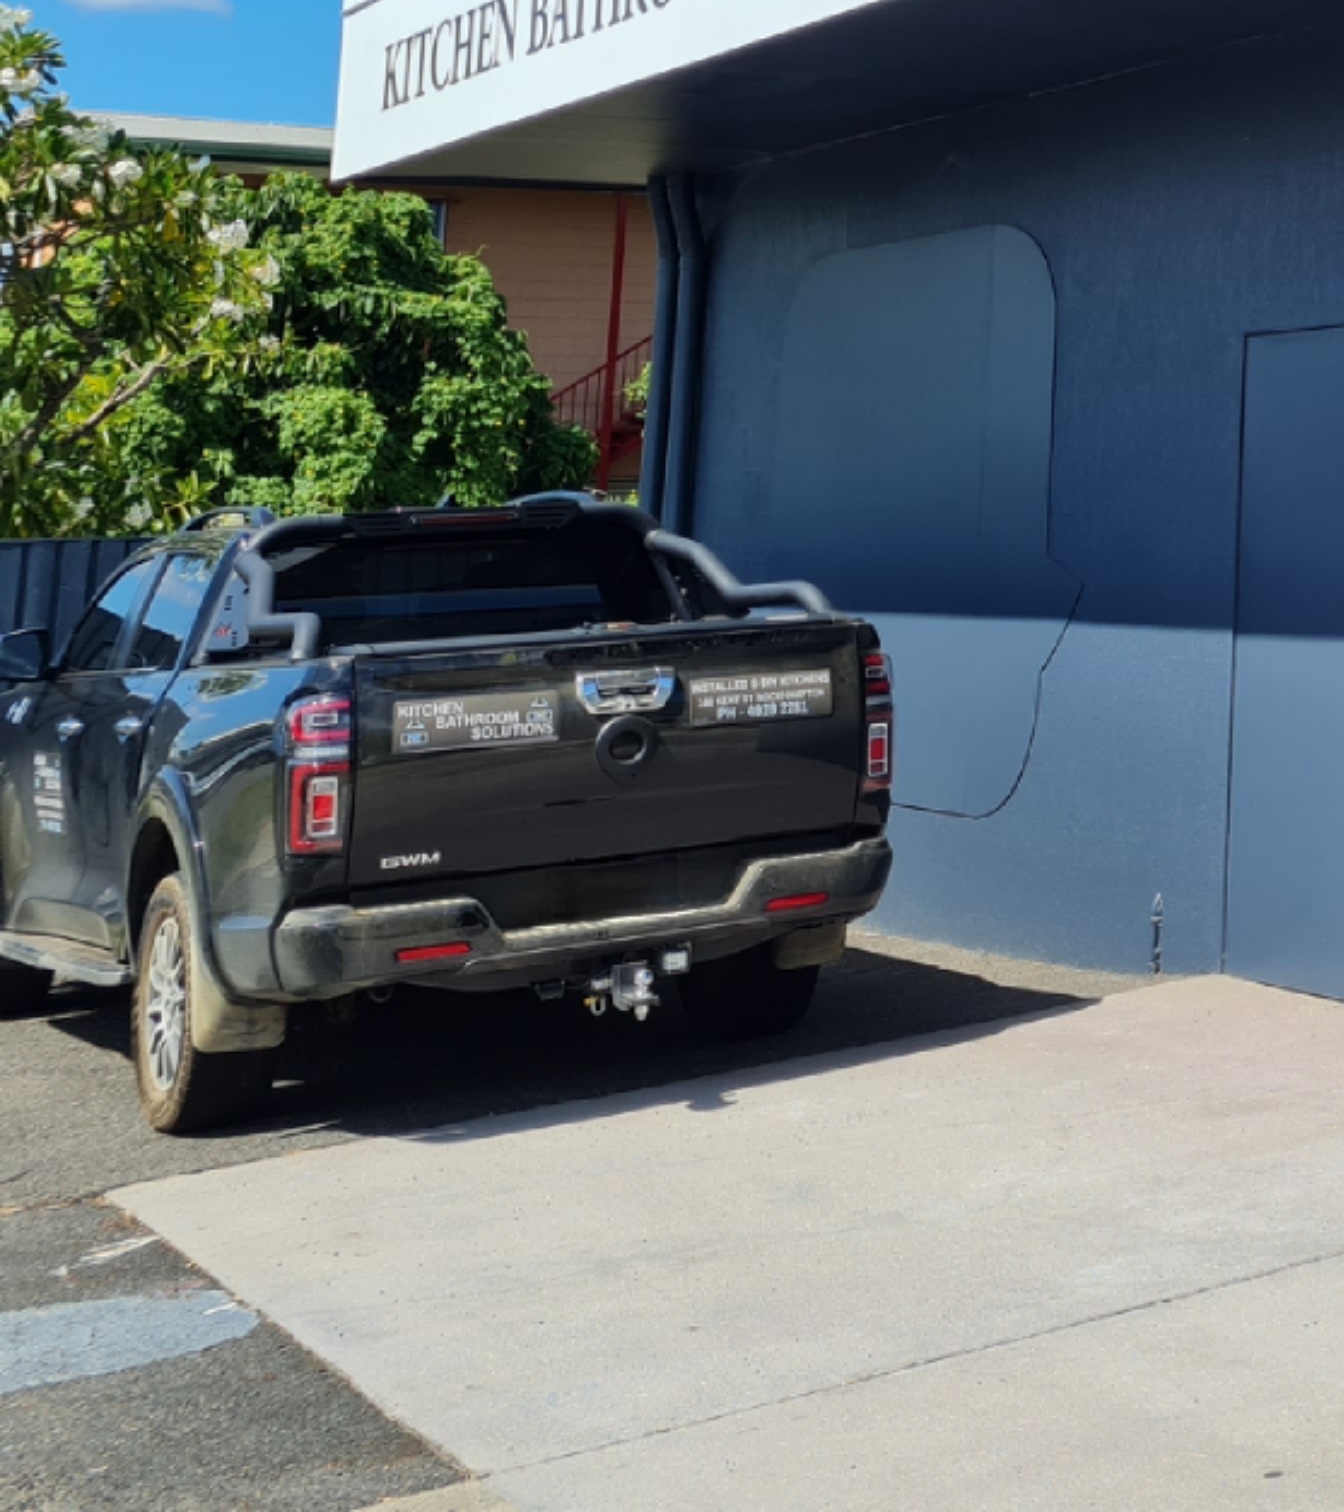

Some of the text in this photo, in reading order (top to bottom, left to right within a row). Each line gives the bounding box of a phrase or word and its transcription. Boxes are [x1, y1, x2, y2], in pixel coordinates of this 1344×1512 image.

[397, 701, 464, 718] KITCHEN
[435, 711, 519, 729] BATHROOM
[470, 723, 554, 741] SOLUTIONS
[381, 850, 441, 868] GWM
